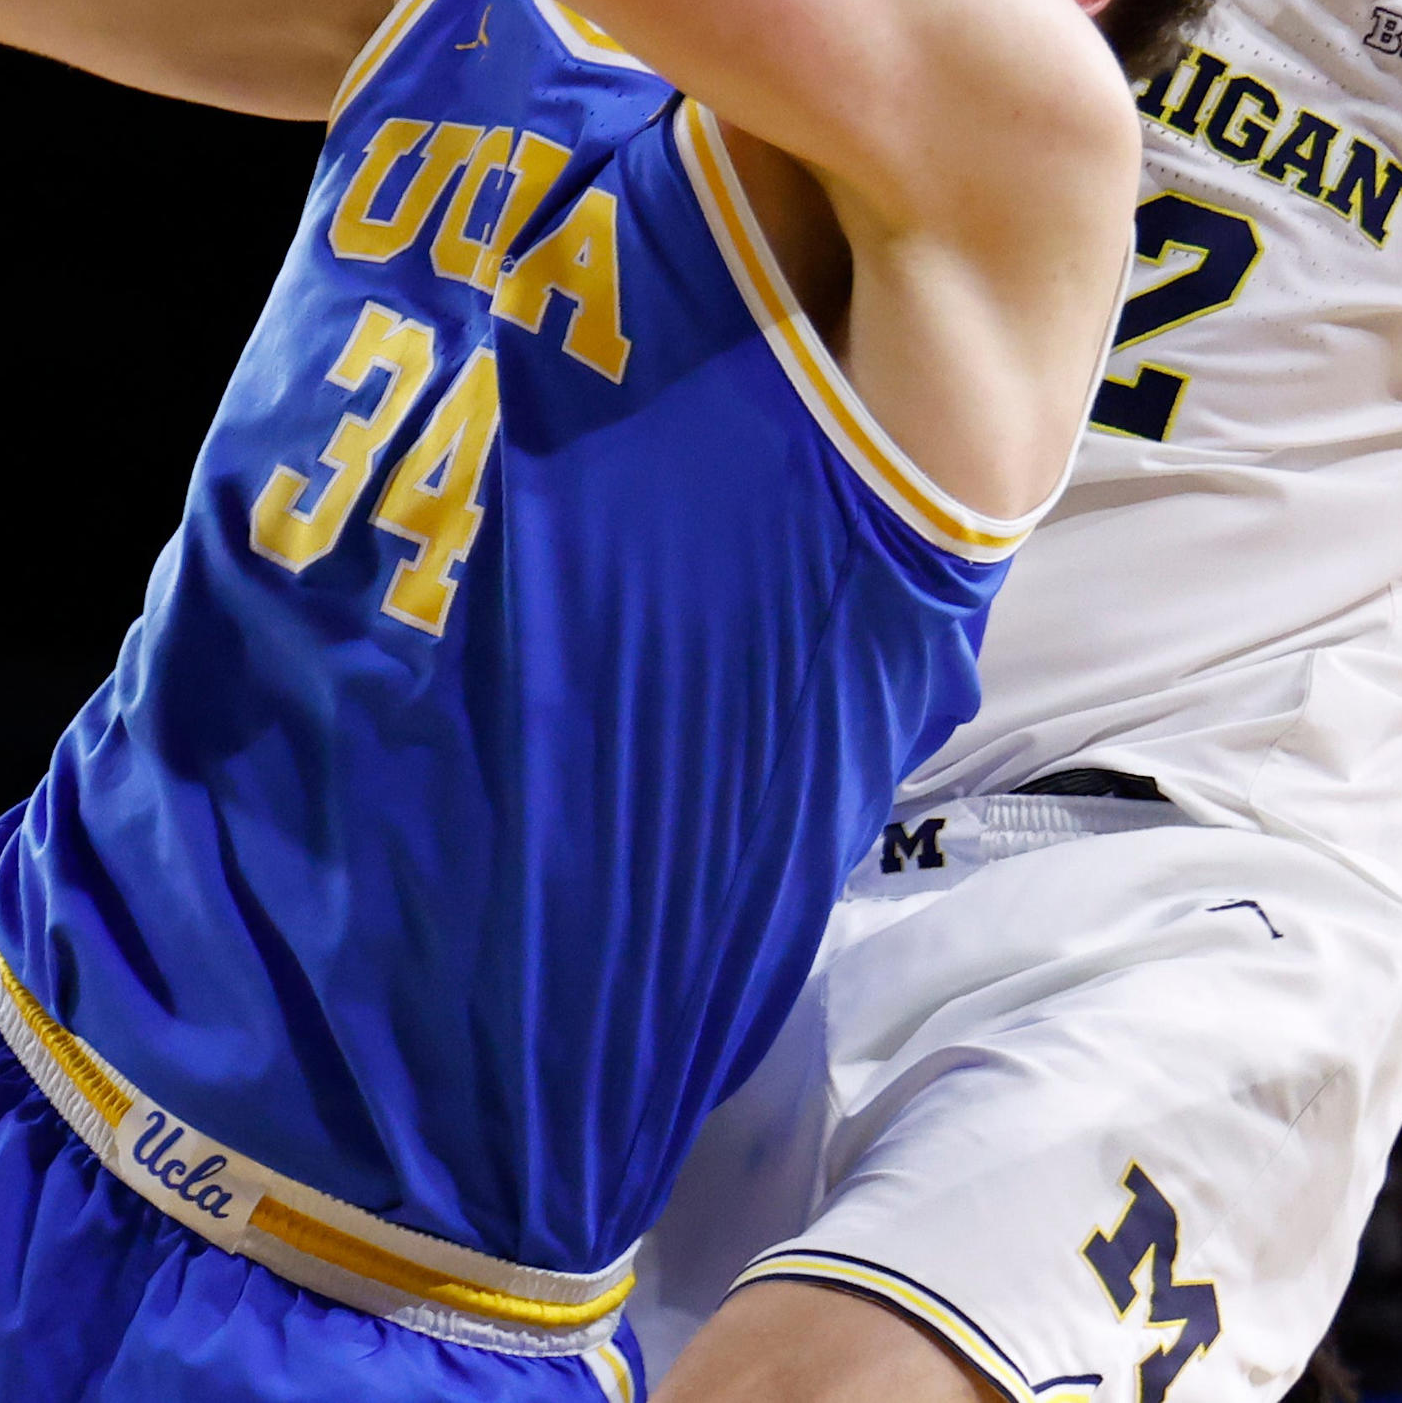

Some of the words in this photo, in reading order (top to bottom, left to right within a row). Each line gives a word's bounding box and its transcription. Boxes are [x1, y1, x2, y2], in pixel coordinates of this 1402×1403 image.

[249, 301, 501, 636] 34
[879, 817, 948, 874] M
[133, 1110, 233, 1219] Ucla
[1079, 1158, 1222, 1403] M
